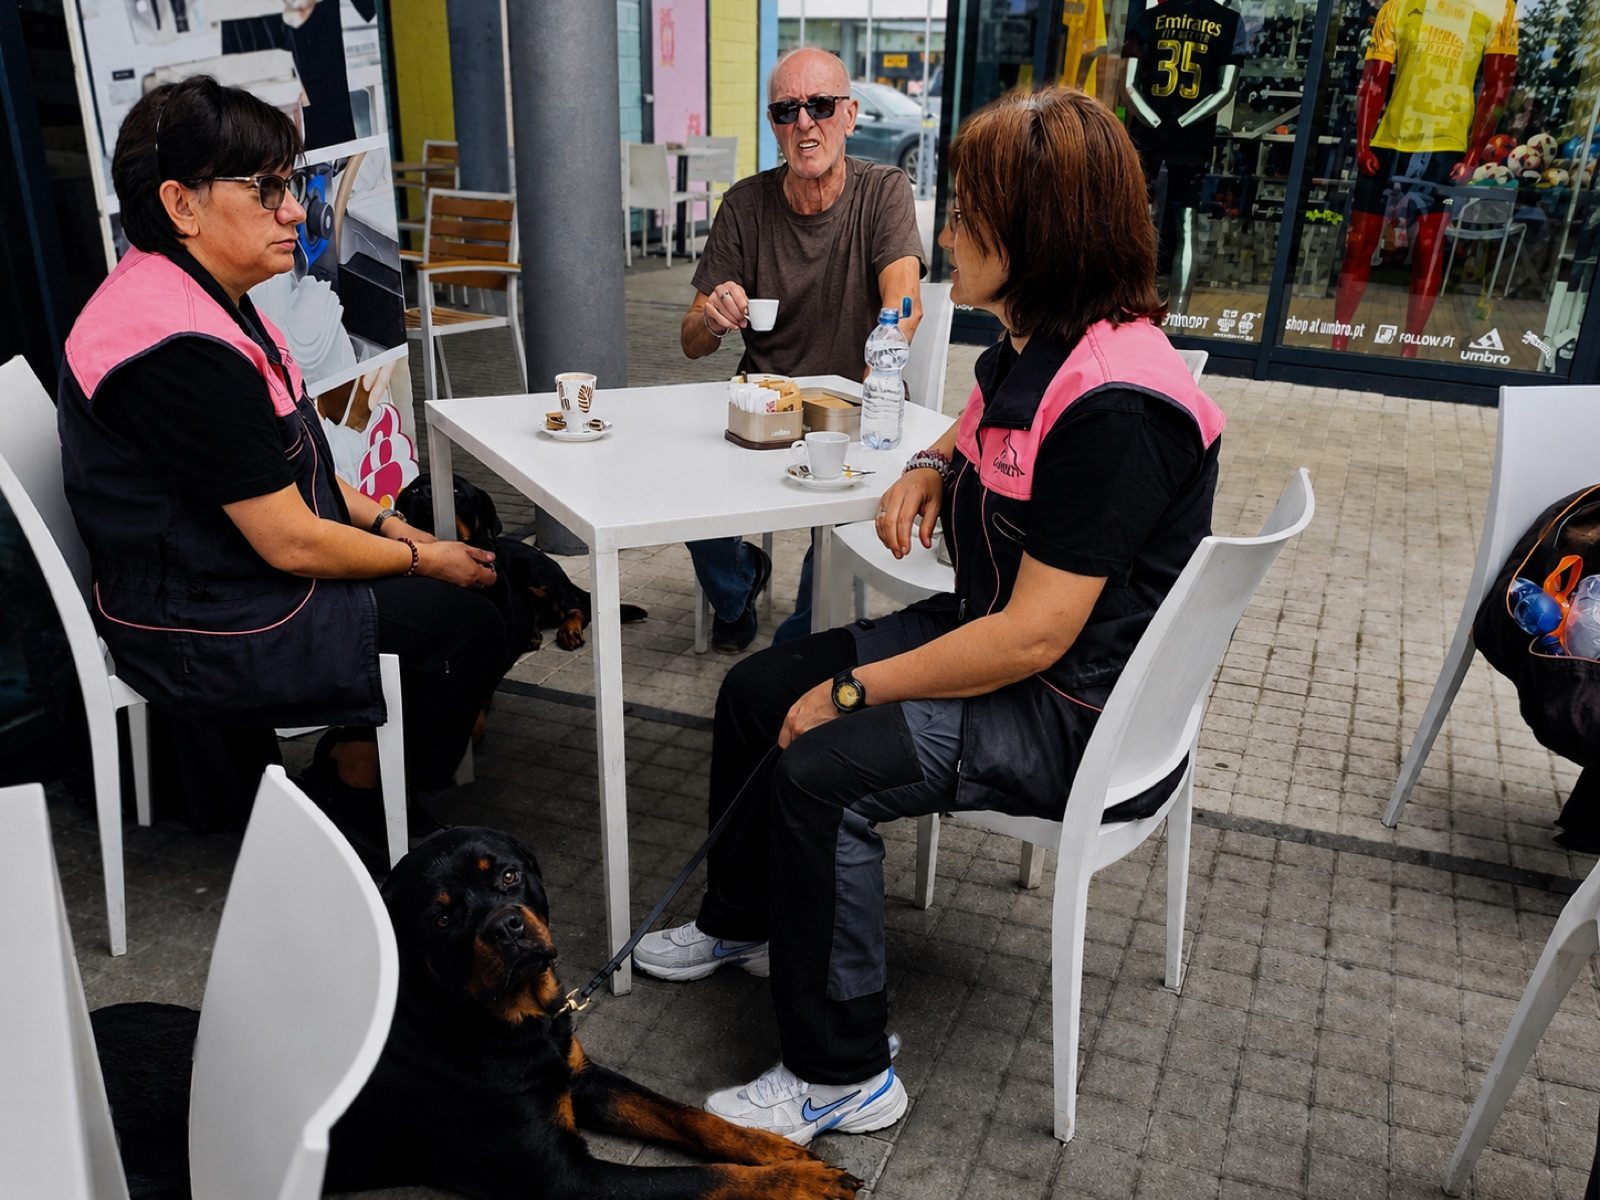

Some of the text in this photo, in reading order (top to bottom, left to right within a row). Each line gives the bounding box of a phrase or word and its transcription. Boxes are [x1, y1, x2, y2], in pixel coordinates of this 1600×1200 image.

[1155, 14, 1222, 37] Emirates
[1151, 40, 1209, 99] 35
[1285, 315, 1308, 335] shop
[1320, 320, 1365, 340] umbro.pt
[1460, 350, 1511, 366] umbro
